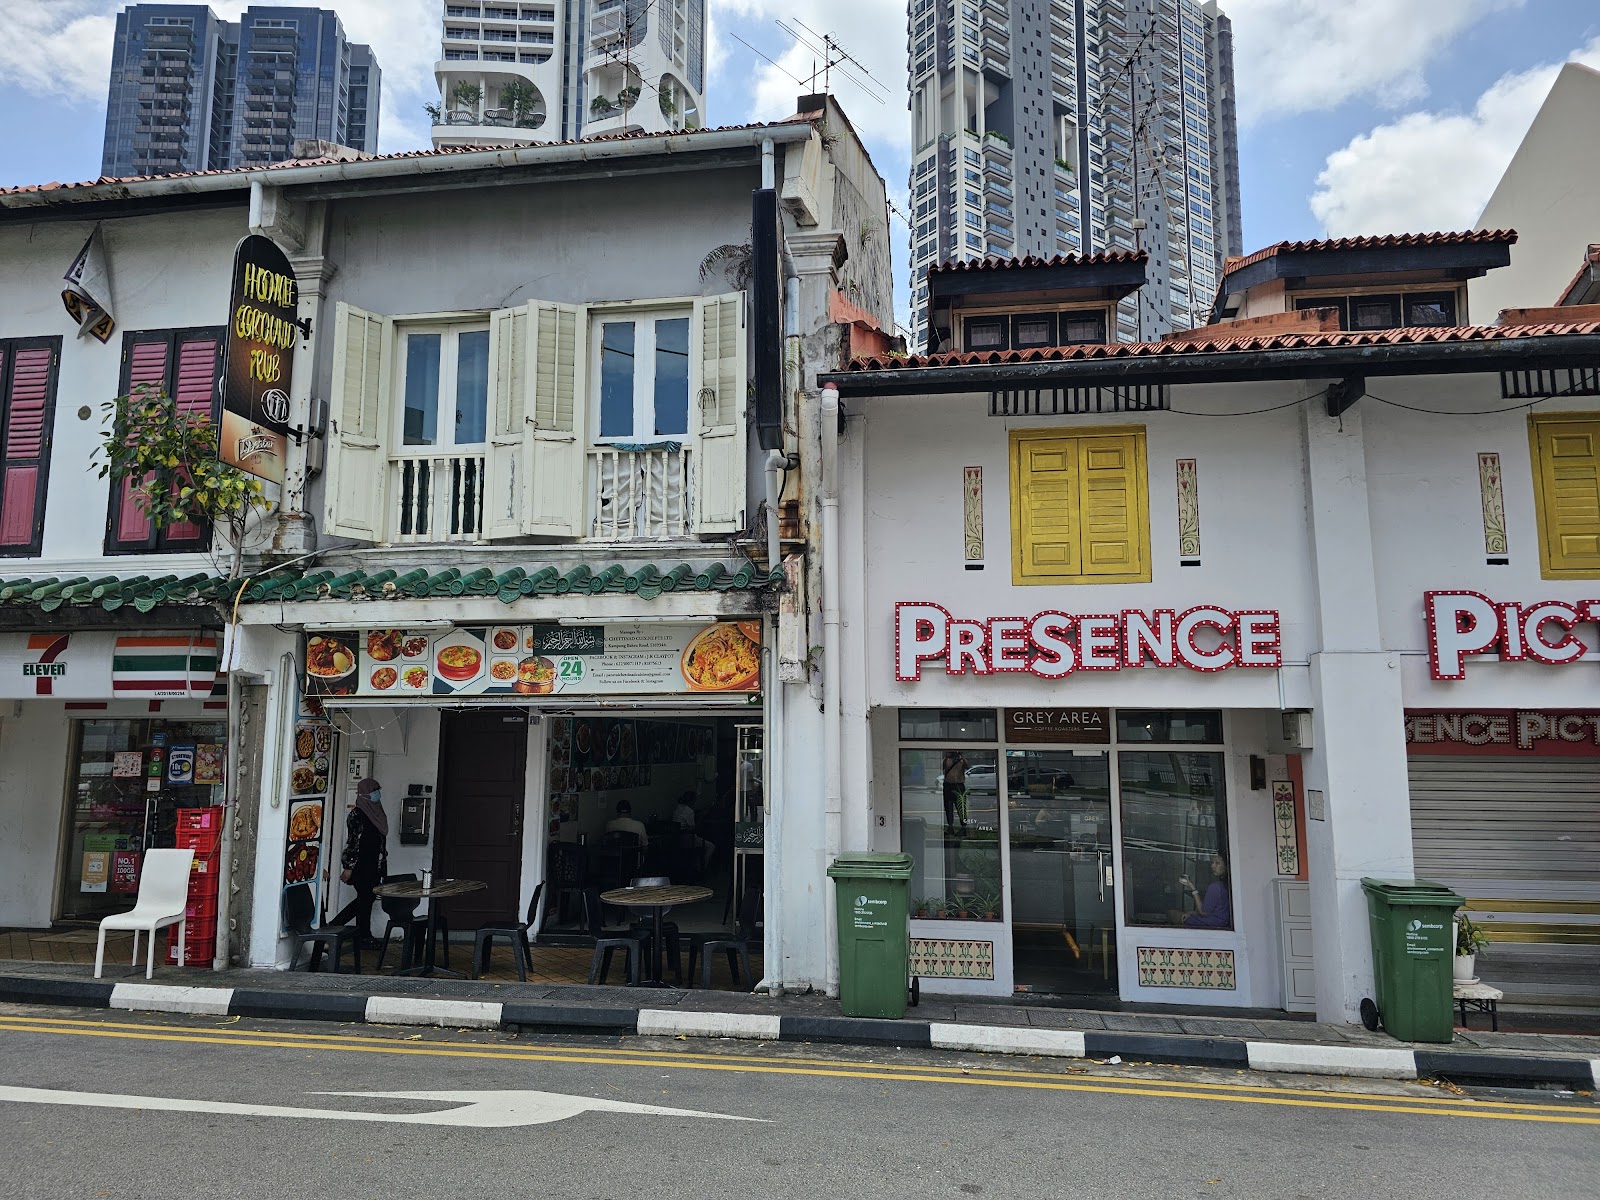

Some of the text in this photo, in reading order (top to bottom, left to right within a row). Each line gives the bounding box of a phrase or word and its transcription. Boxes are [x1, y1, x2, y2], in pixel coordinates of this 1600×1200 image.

[244, 262, 298, 308] HOME
[235, 304, 297, 350] GROUND
[249, 349, 281, 383] PUB
[895, 601, 1281, 682] PRESENCE
[1424, 590, 1600, 681] PIC
[27, 634, 70, 695] 7
[560, 661, 582, 676] 24
[1013, 712, 1102, 724] GREY AREA
[880, 816, 885, 826] 3
